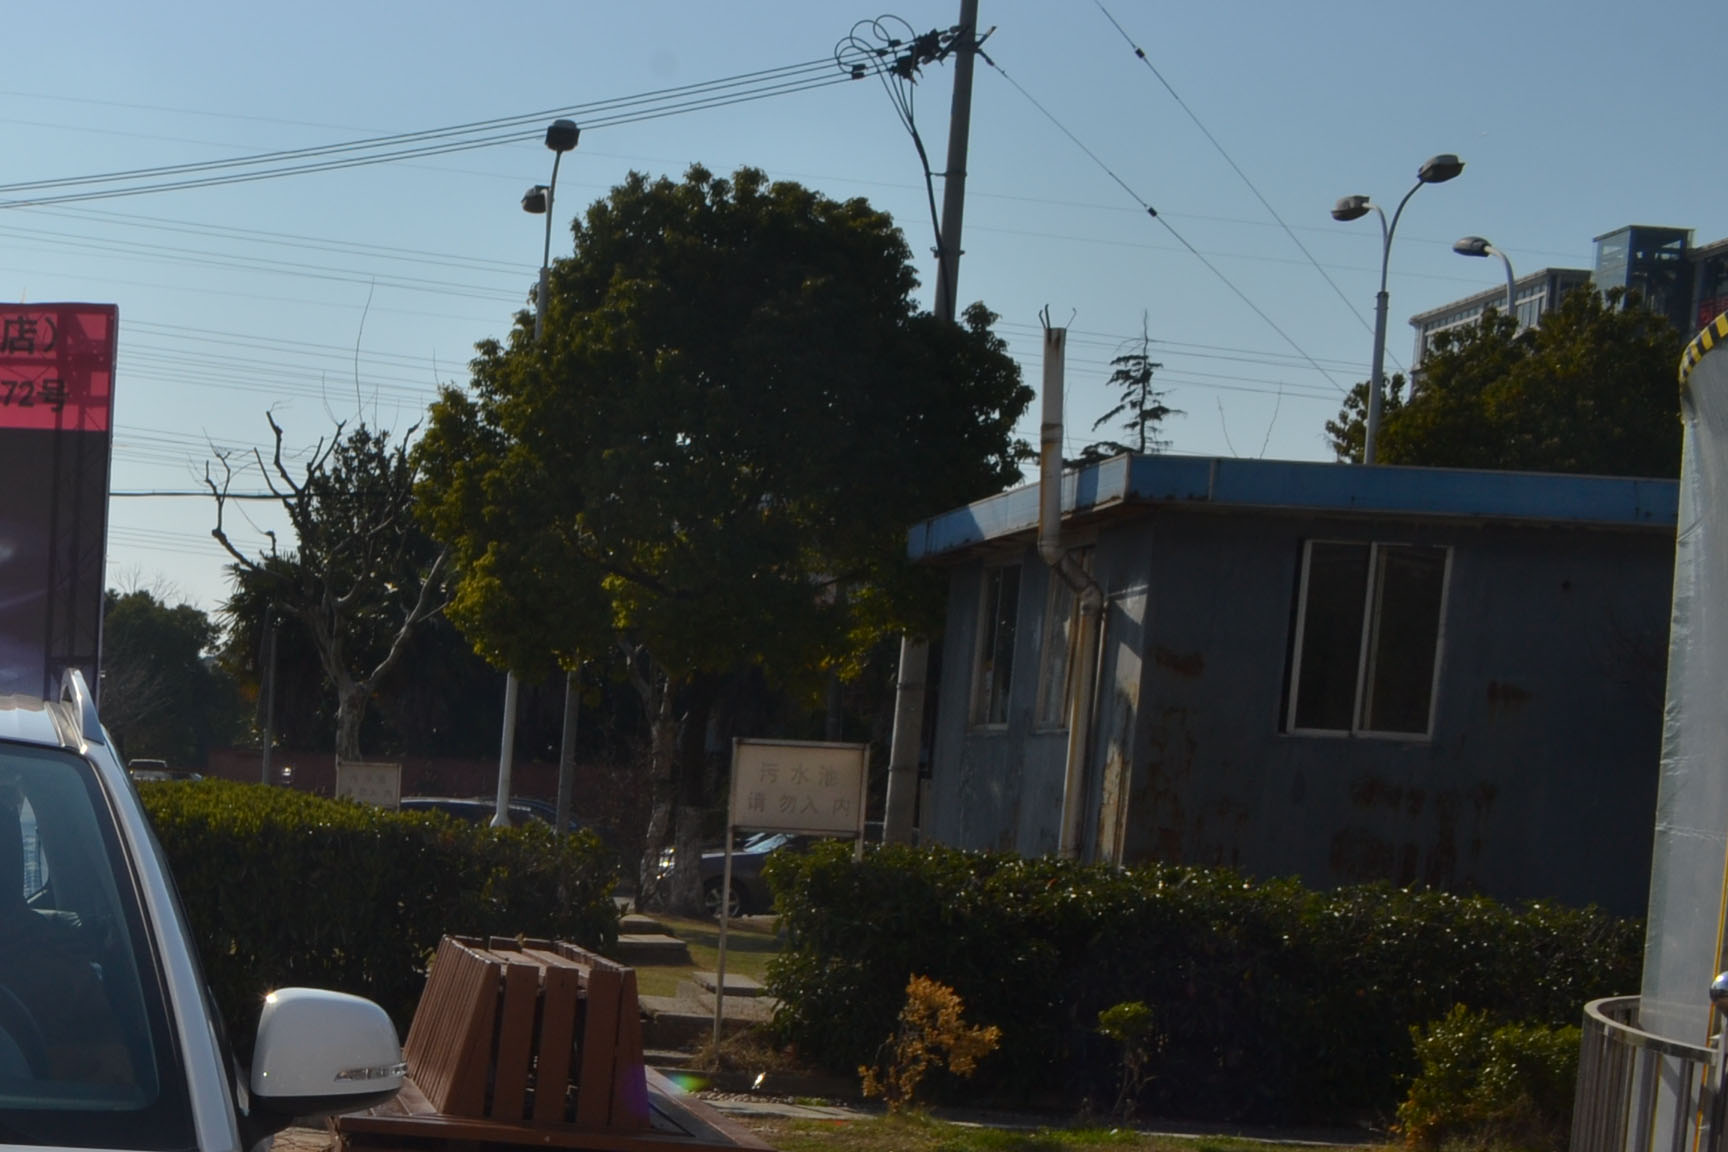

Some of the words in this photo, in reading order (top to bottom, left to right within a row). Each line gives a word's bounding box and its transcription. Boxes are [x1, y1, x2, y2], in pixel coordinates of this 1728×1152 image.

[759, 761, 840, 787] 污水池
[746, 791, 852, 817] 请勿入内
